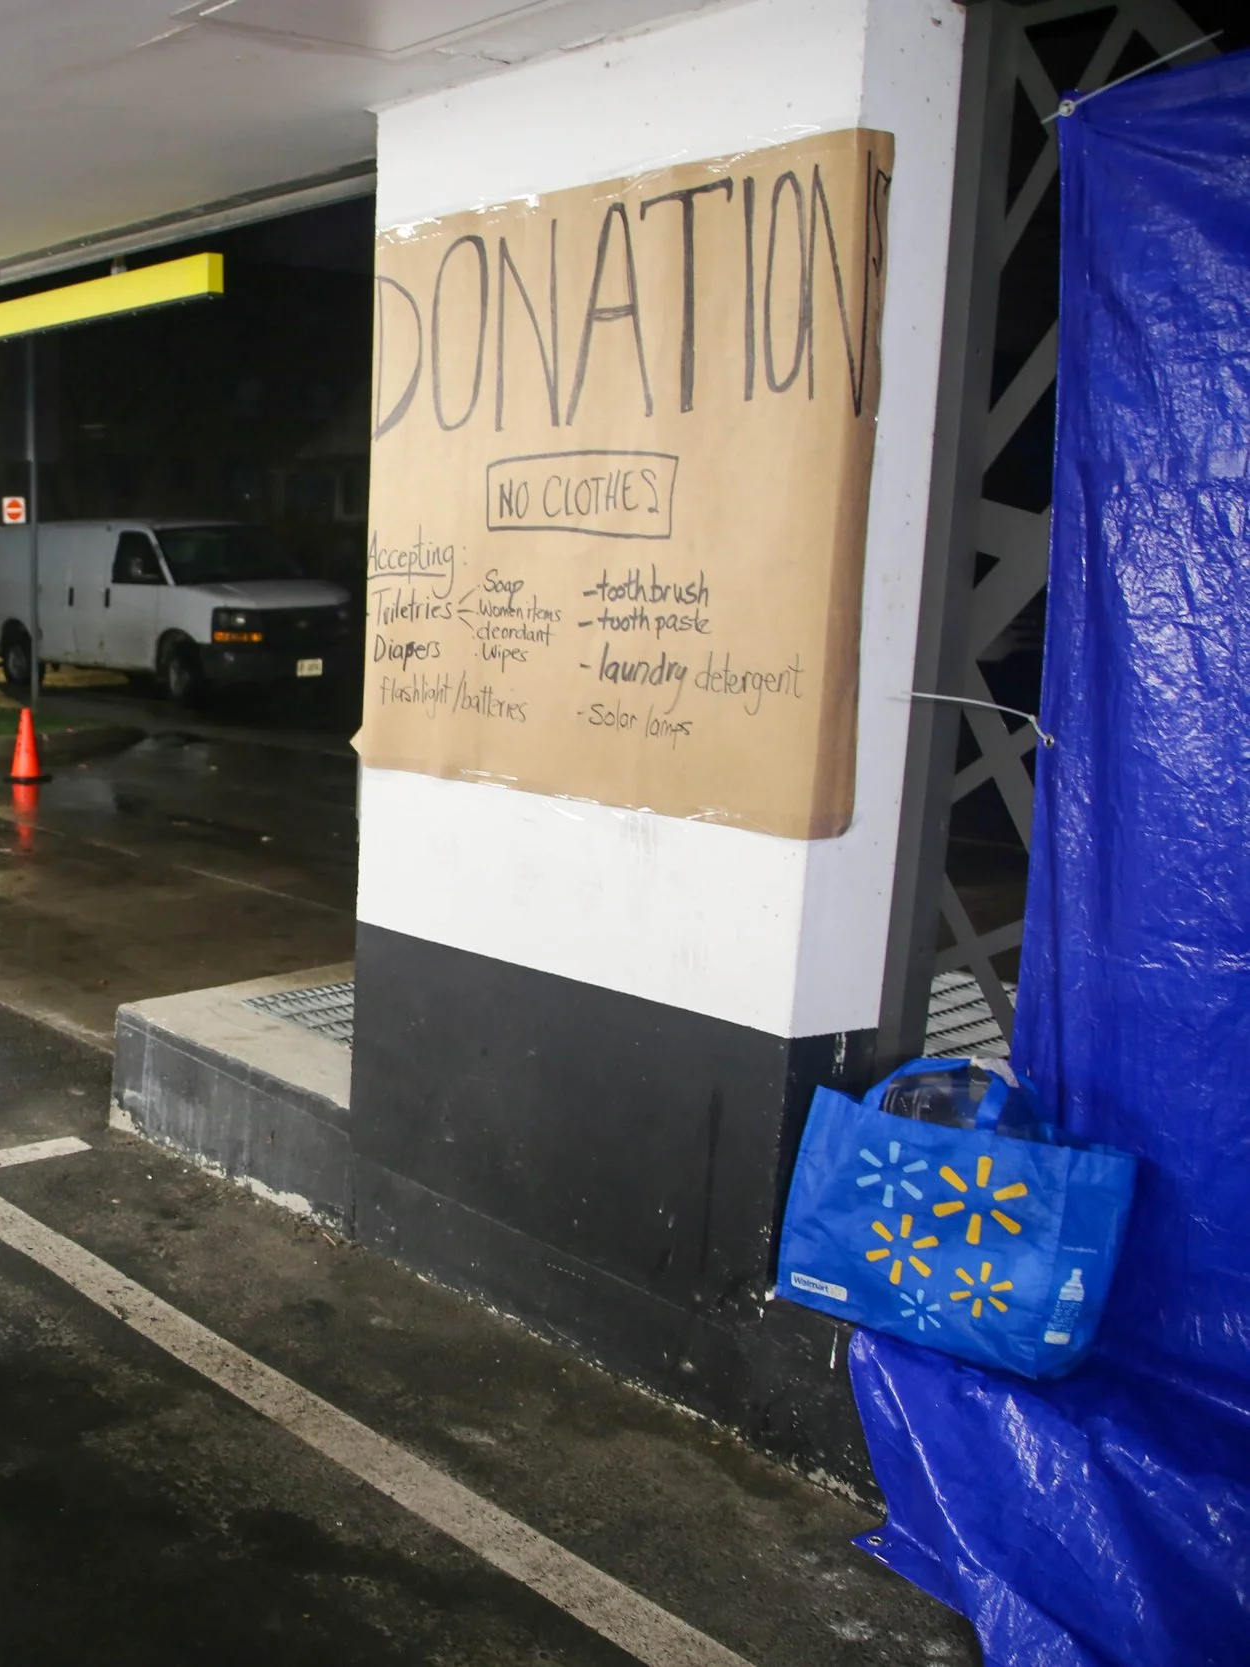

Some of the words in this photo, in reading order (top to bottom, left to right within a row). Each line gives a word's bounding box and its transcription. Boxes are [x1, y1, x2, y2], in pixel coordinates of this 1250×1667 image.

[499, 478, 530, 519] NO
[543, 469, 659, 518] CLOTHES
[483, 568, 524, 610] Soap
[373, 633, 442, 672] Diapers
[482, 642, 529, 674] Wipes
[599, 641, 688, 716] laundry
[694, 650, 805, 717] detergent
[793, 1274, 829, 1293] Walmart
